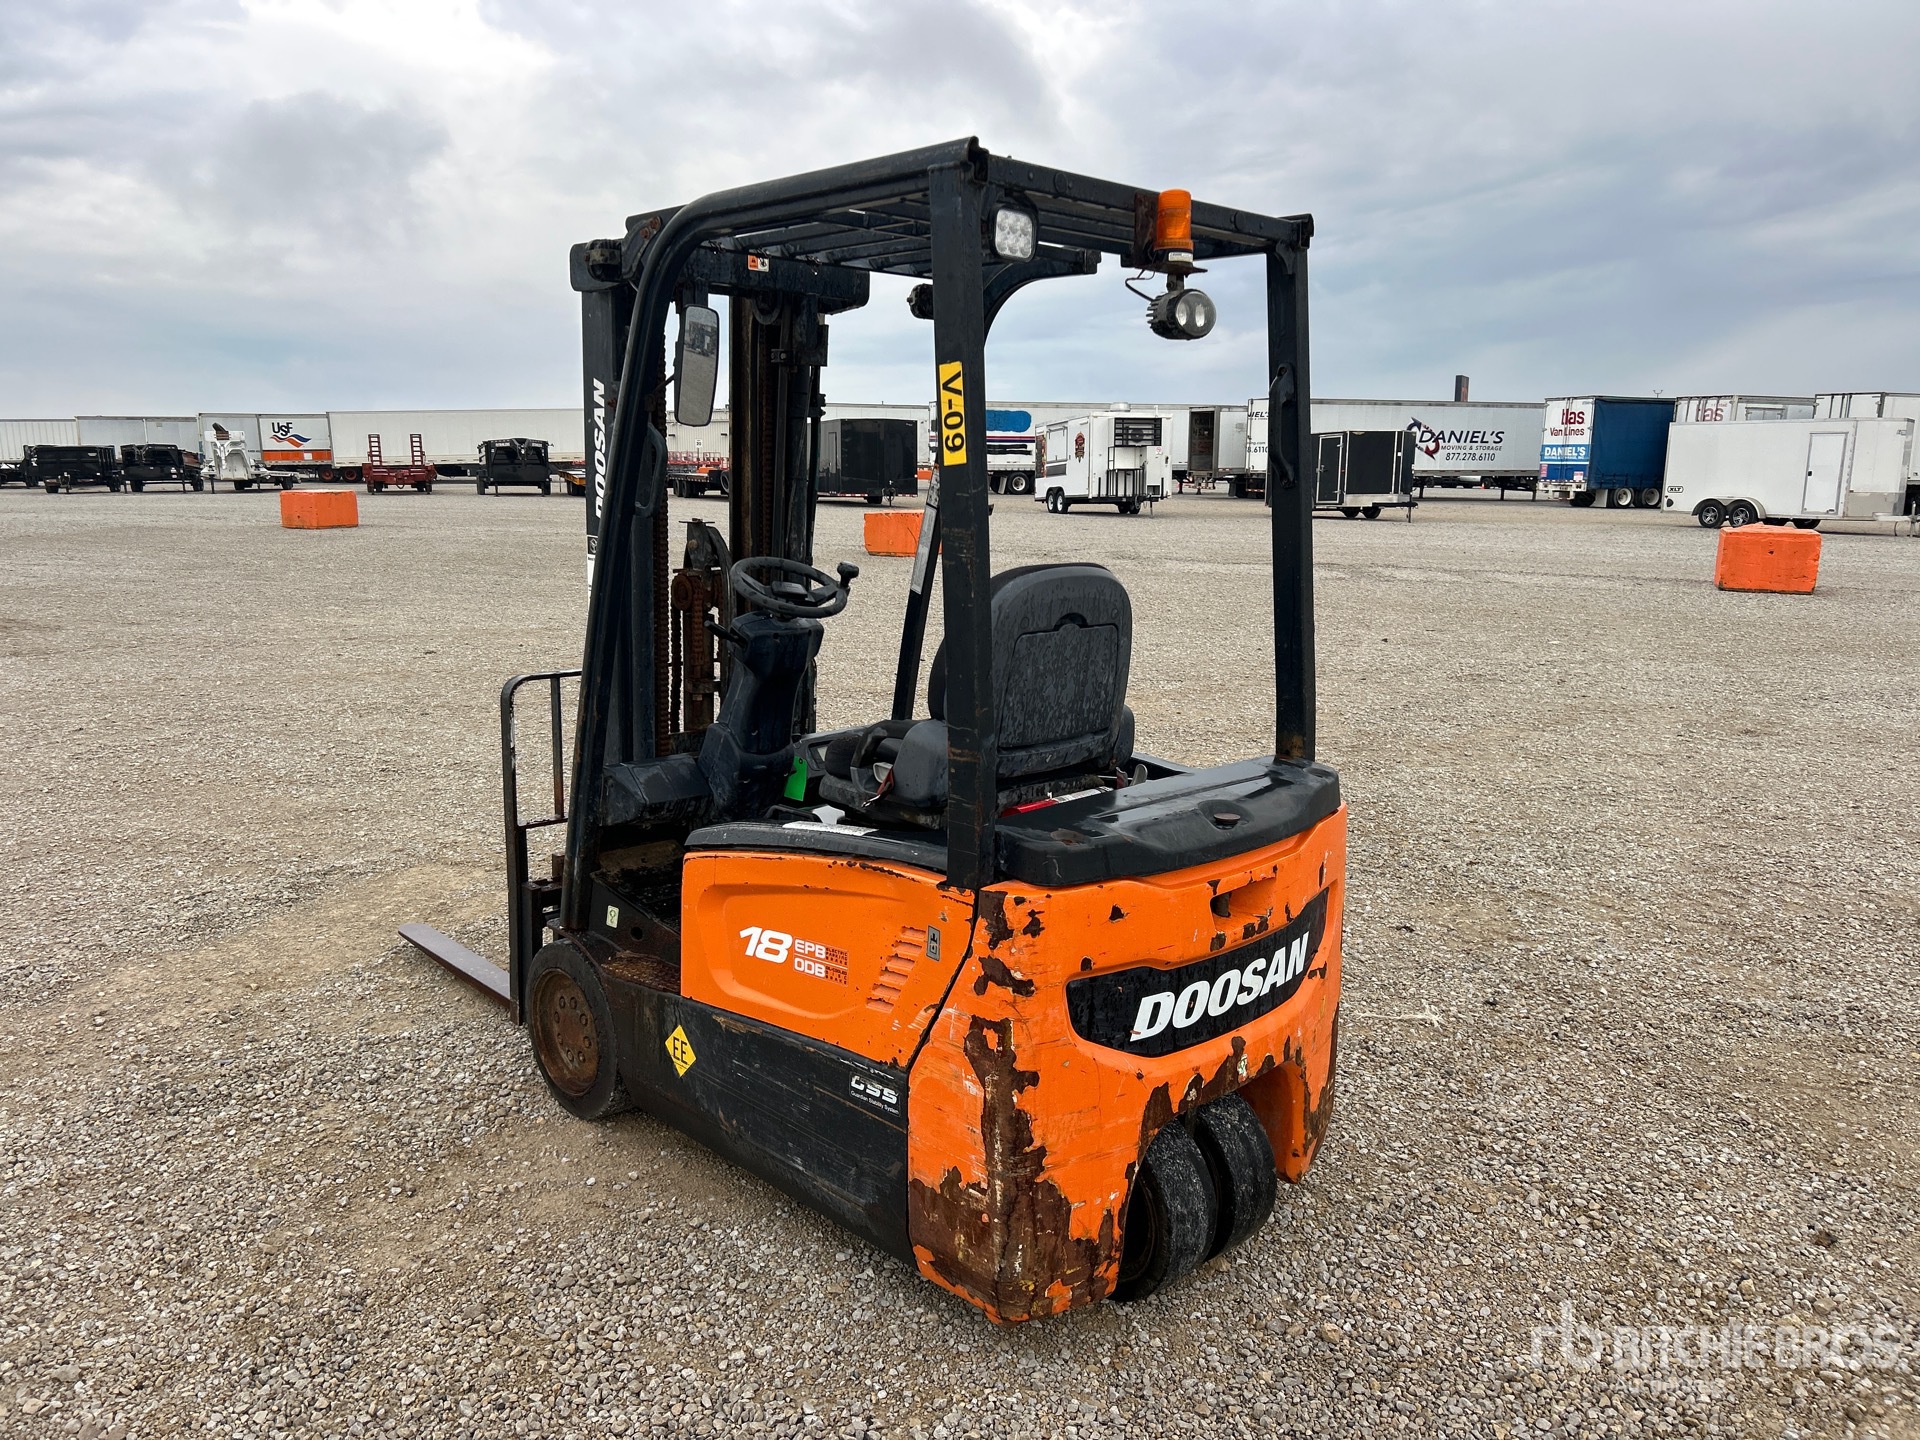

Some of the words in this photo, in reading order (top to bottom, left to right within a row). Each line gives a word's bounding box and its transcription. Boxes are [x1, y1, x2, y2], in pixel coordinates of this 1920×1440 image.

[941, 370, 965, 454] V-09
[271, 421, 293, 437] USF
[1418, 430, 1505, 444] DANIEL'S
[1550, 427, 1563, 436] Van
[1564, 426, 1585, 436] Lines
[1445, 452, 1496, 462] 877.278.6110
[739, 925, 793, 964] 18
[794, 938, 826, 959] EPB
[1130, 931, 1310, 1042] DOOSAN
[673, 1036, 688, 1065] EE
